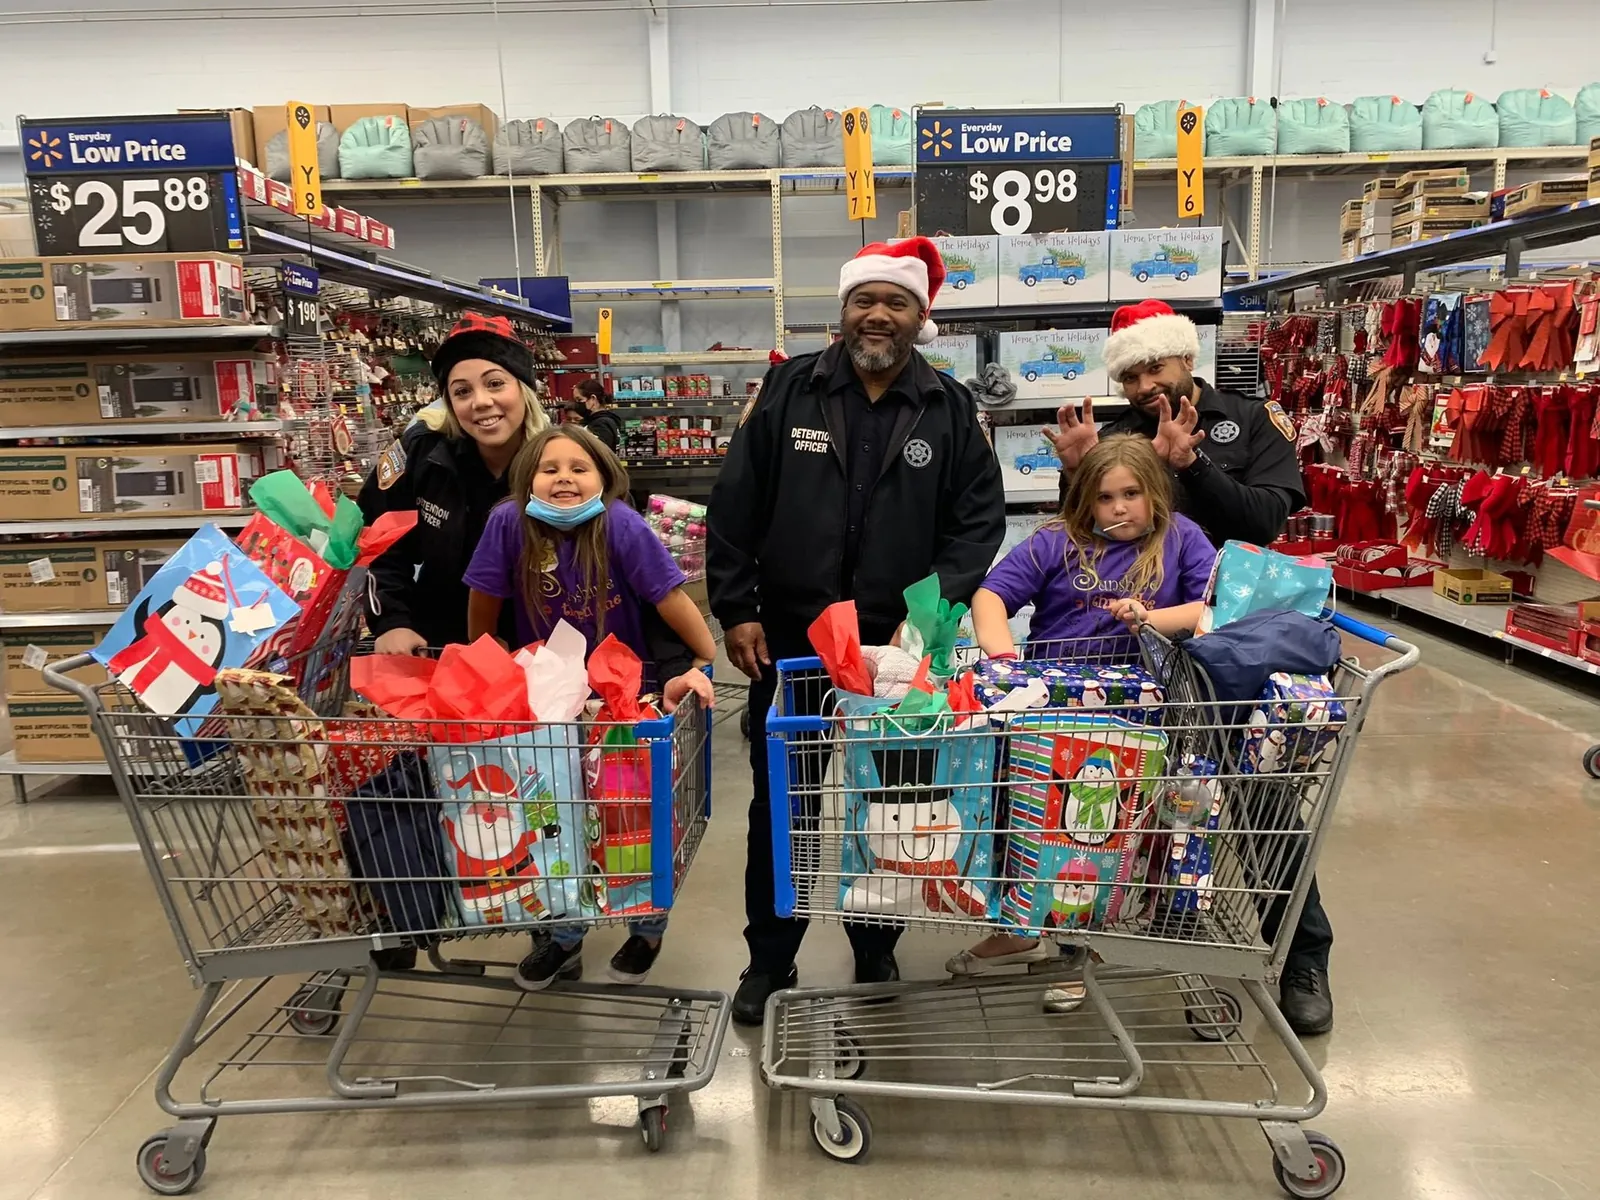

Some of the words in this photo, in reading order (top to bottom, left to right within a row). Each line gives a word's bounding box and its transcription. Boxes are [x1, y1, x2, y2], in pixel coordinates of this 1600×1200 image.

[961, 122, 1002, 133] Everyday
[68, 132, 112, 142] Everyday
[961, 133, 1010, 154] Low
[1014, 130, 1072, 153] Price
[69, 142, 121, 164] Low
[124, 138, 186, 163] Price
[300, 165, 314, 185] Y
[848, 170, 858, 190] Y
[863, 169, 871, 188] Y
[1182, 167, 1196, 188] Y
[305, 192, 315, 210] 8
[851, 196, 858, 215] 7
[866, 195, 872, 213] 7
[1184, 194, 1195, 212] 6
[1010, 238, 1031, 248] Home
[1035, 237, 1048, 246] For
[1051, 236, 1065, 246] The
[1067, 235, 1100, 247] Holidays
[1123, 234, 1144, 243] Home
[1148, 233, 1161, 242] For
[1163, 232, 1177, 242] The
[1181, 231, 1214, 243] Holidays
[940, 240, 955, 250] The
[957, 239, 990, 251] Holidays
[1239, 295, 1260, 308] Spill
[937, 339, 969, 350] Holidays
[1011, 334, 1032, 344] Home
[1035, 334, 1048, 343] For
[1051, 333, 1065, 343] The
[1067, 331, 1100, 343] Holidays
[791, 427, 832, 442] DETENTIO
[1006, 430, 1027, 440] Home
[794, 440, 828, 453] OFFICER
